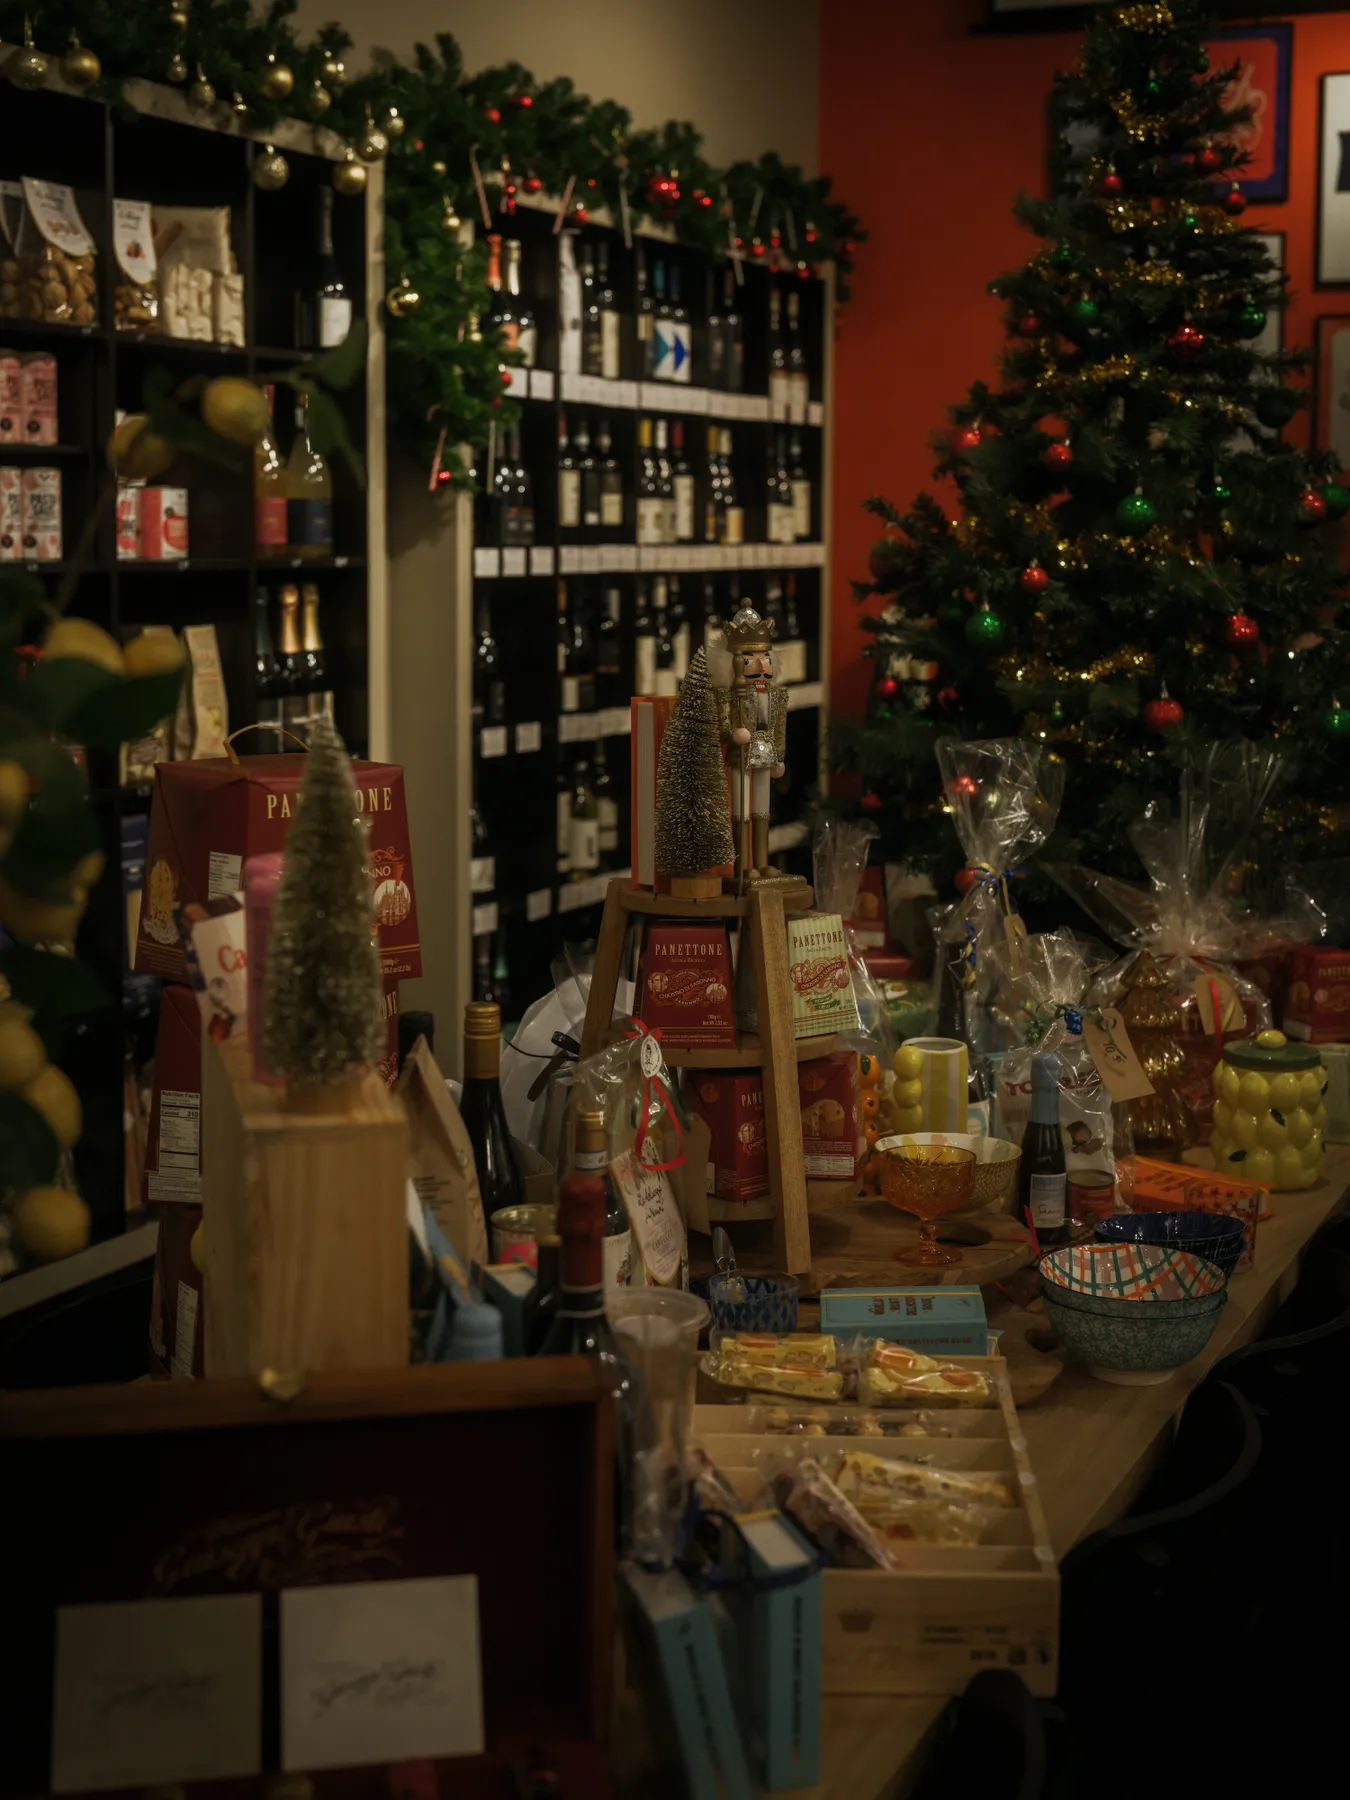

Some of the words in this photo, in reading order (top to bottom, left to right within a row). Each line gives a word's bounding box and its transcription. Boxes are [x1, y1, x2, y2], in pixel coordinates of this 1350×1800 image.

[266, 787, 392, 820] PAONE
[793, 930, 843, 949] PANETTONE
[654, 943, 723, 956] PANETTONE
